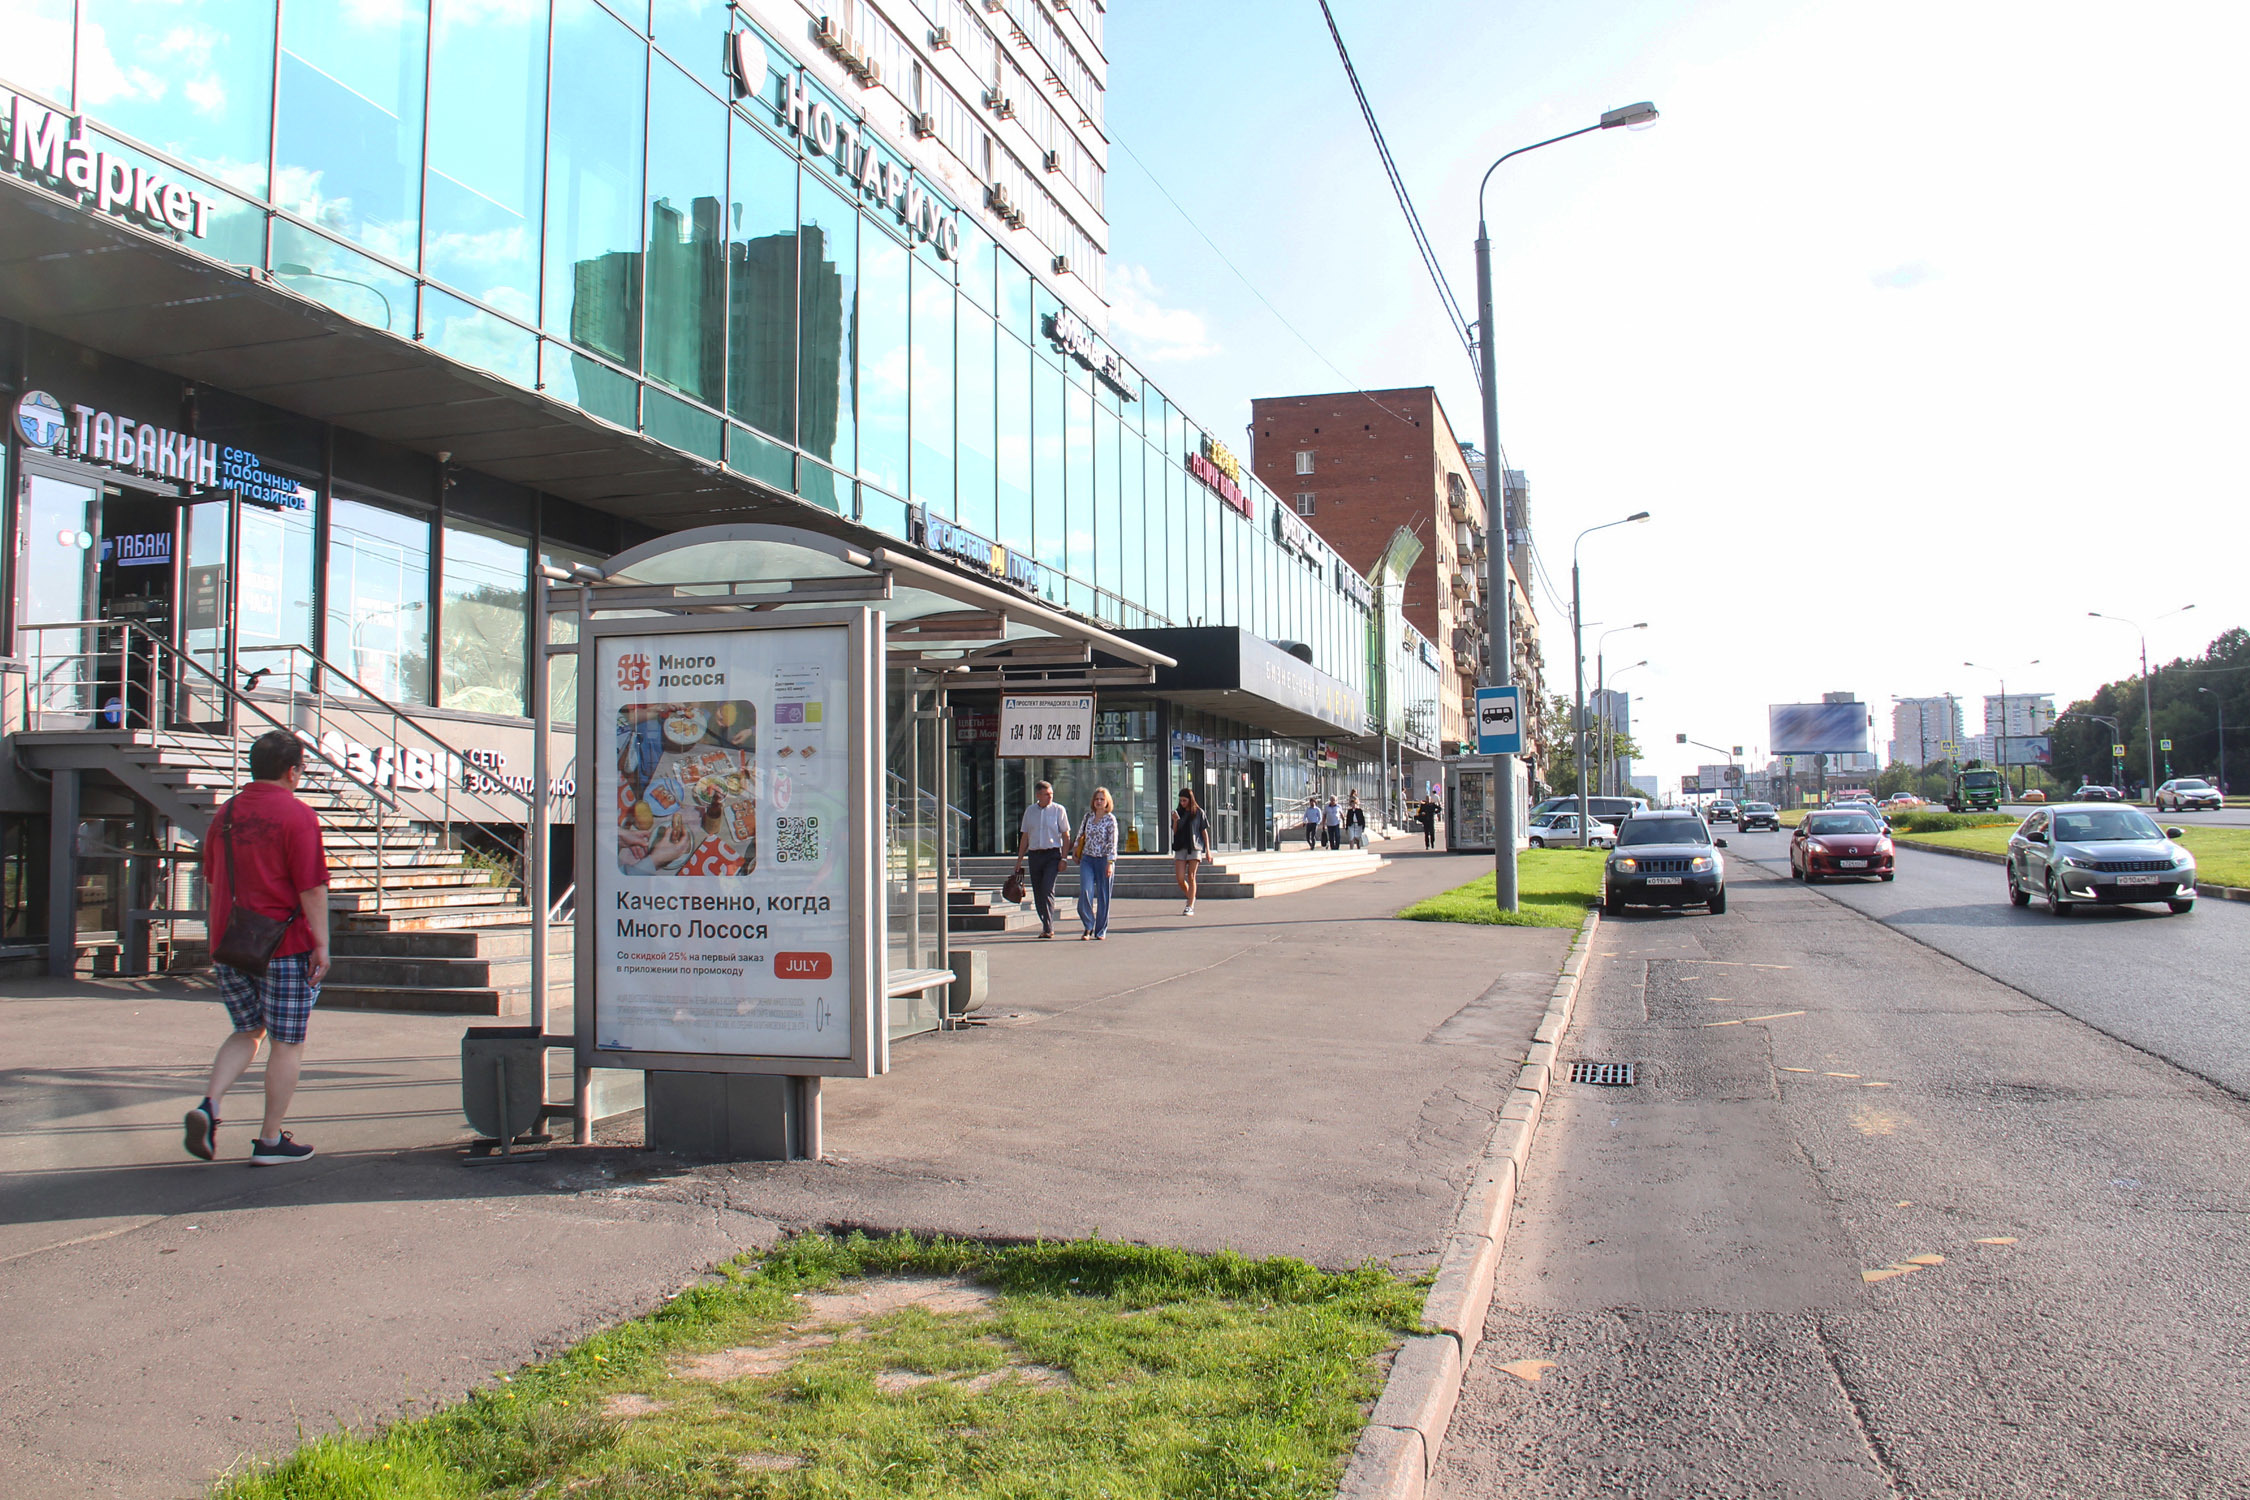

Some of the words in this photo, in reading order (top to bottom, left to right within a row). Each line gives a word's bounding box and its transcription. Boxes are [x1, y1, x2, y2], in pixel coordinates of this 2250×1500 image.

[11, 95, 216, 240] Маркет
[784, 71, 960, 262] НОТАРИУС
[70, 403, 218, 488] ТАБАКИН
[223, 446, 260, 468] сеть
[222, 462, 301, 495] табачных
[221, 477, 306, 510] магазинов
[658, 655, 716, 670] Много
[658, 673, 725, 688] лосося
[1265, 660, 1320, 701] БИЗНЕС-ЦЕНТР
[1326, 686, 1356, 722] ЛЕТО
[958, 718, 985, 728] ЦВЕТЫ
[1095, 711, 1130, 724] АЛОН
[1010, 724, 1024, 740] т34
[1029, 724, 1043, 740] 138
[1047, 724, 1061, 740] 224
[1066, 724, 1081, 740] 266
[469, 748, 508, 769] СЕТЬ
[468, 772, 576, 797] ЗООМАГАИНО
[616, 891, 761, 914] Качественно,
[767, 896, 831, 914] когда
[616, 919, 682, 938] Много
[687, 920, 768, 939] Лосося
[617, 951, 629, 960] Со
[631, 952, 667, 962] скидкой
[669, 952, 688, 961] 25%
[701, 954, 736, 964] первый
[738, 954, 764, 962] заказ
[785, 959, 820, 972] JULY
[624, 965, 678, 975] приложении
[693, 967, 744, 976] промокоду
[816, 996, 832, 1032] 0+
